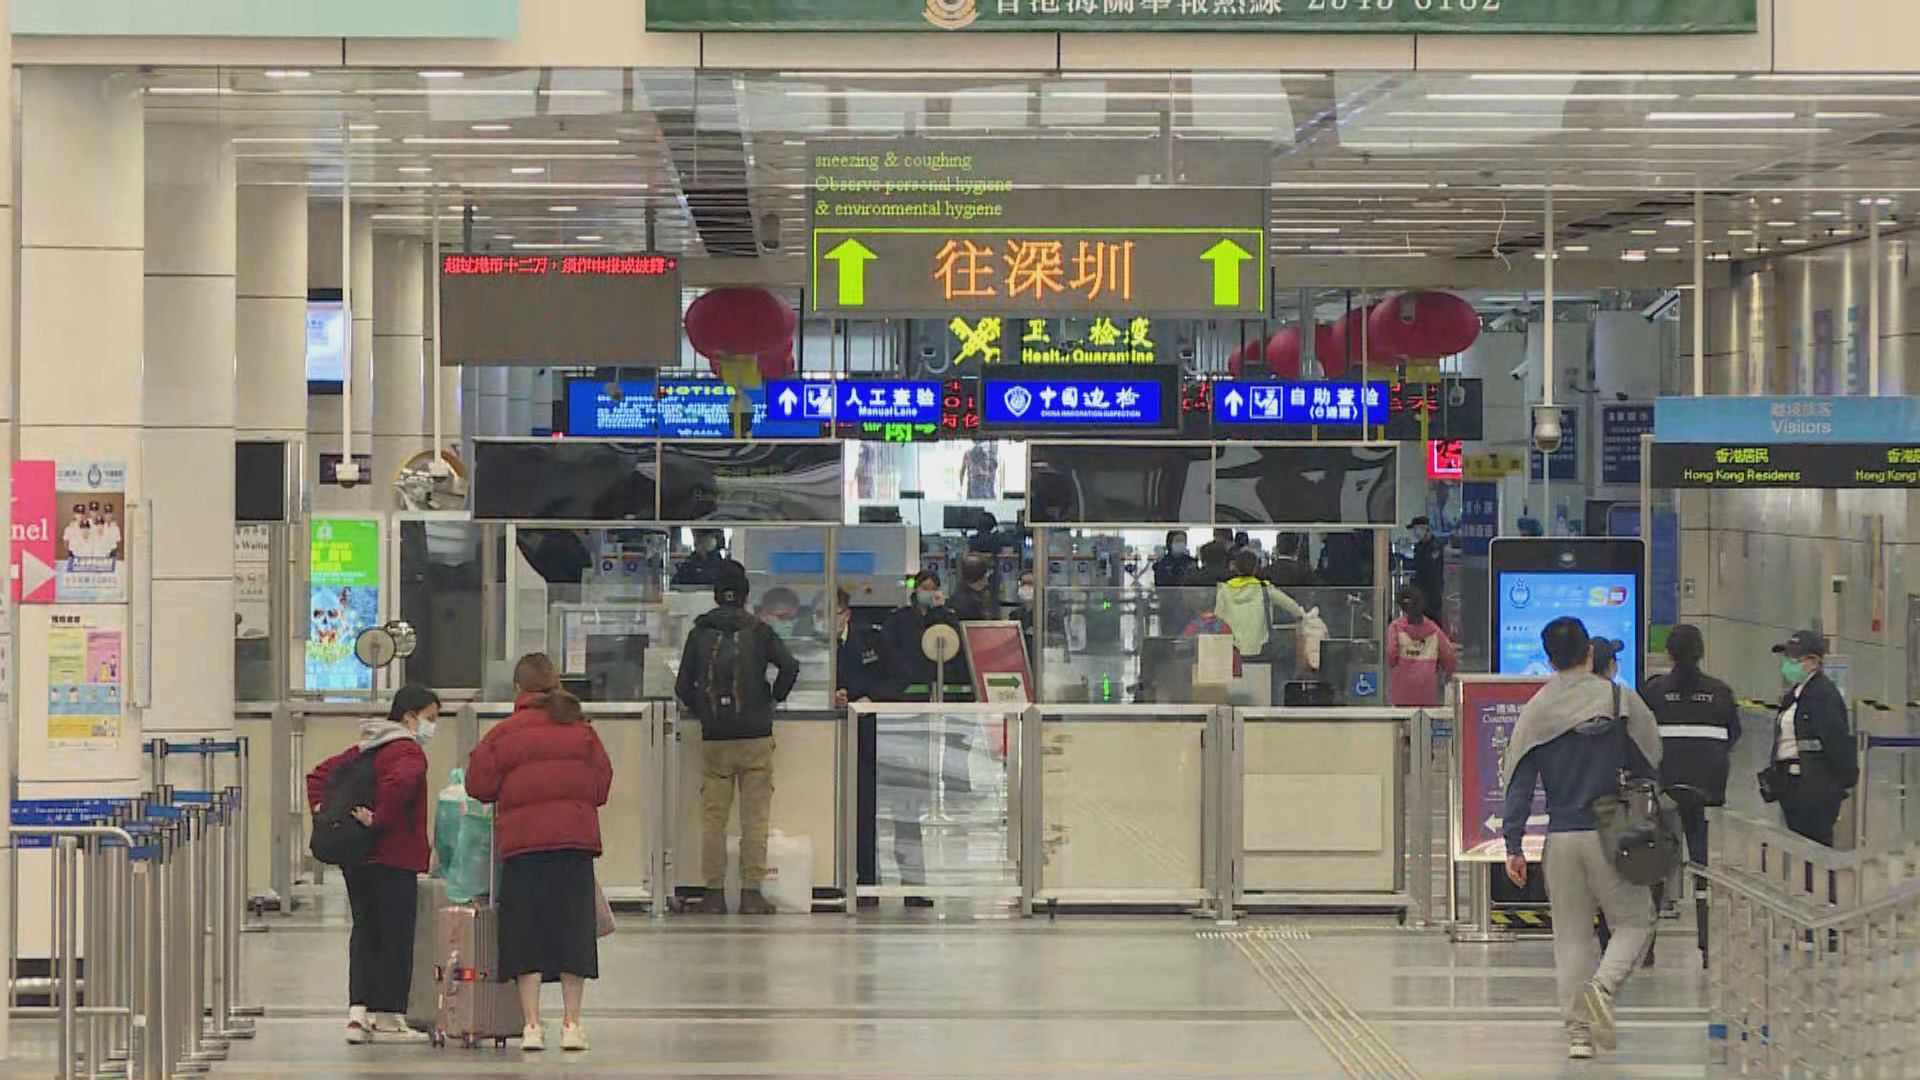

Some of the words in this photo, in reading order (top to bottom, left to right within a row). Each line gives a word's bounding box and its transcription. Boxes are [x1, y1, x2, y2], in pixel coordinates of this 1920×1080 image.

[815, 152, 879, 171] sneezing
[884, 152, 899, 168] &
[904, 152, 973, 171] coughing
[815, 176, 881, 192] Observe
[886, 176, 951, 195] personal
[956, 176, 1014, 195] hygiene
[815, 201, 830, 216] &
[835, 201, 941, 216] environmental
[946, 201, 1003, 219] hygiene
[934, 239, 1135, 301] 往深圳
[1022, 316, 1154, 347] 卫检疫
[1073, 348, 1154, 364] Quarantine
[846, 388, 935, 407] 人工查验
[1290, 386, 1379, 407] 自助查验
[859, 406, 893, 417] Manual
[894, 406, 918, 417] Lane
[1771, 420, 1833, 434] Visitors
[1684, 469, 1714, 483] Hong
[1716, 469, 1745, 483] Kong
[1747, 468, 1801, 481] Residents
[1855, 470, 1886, 483] Hong
[1888, 470, 1917, 483] Kong
